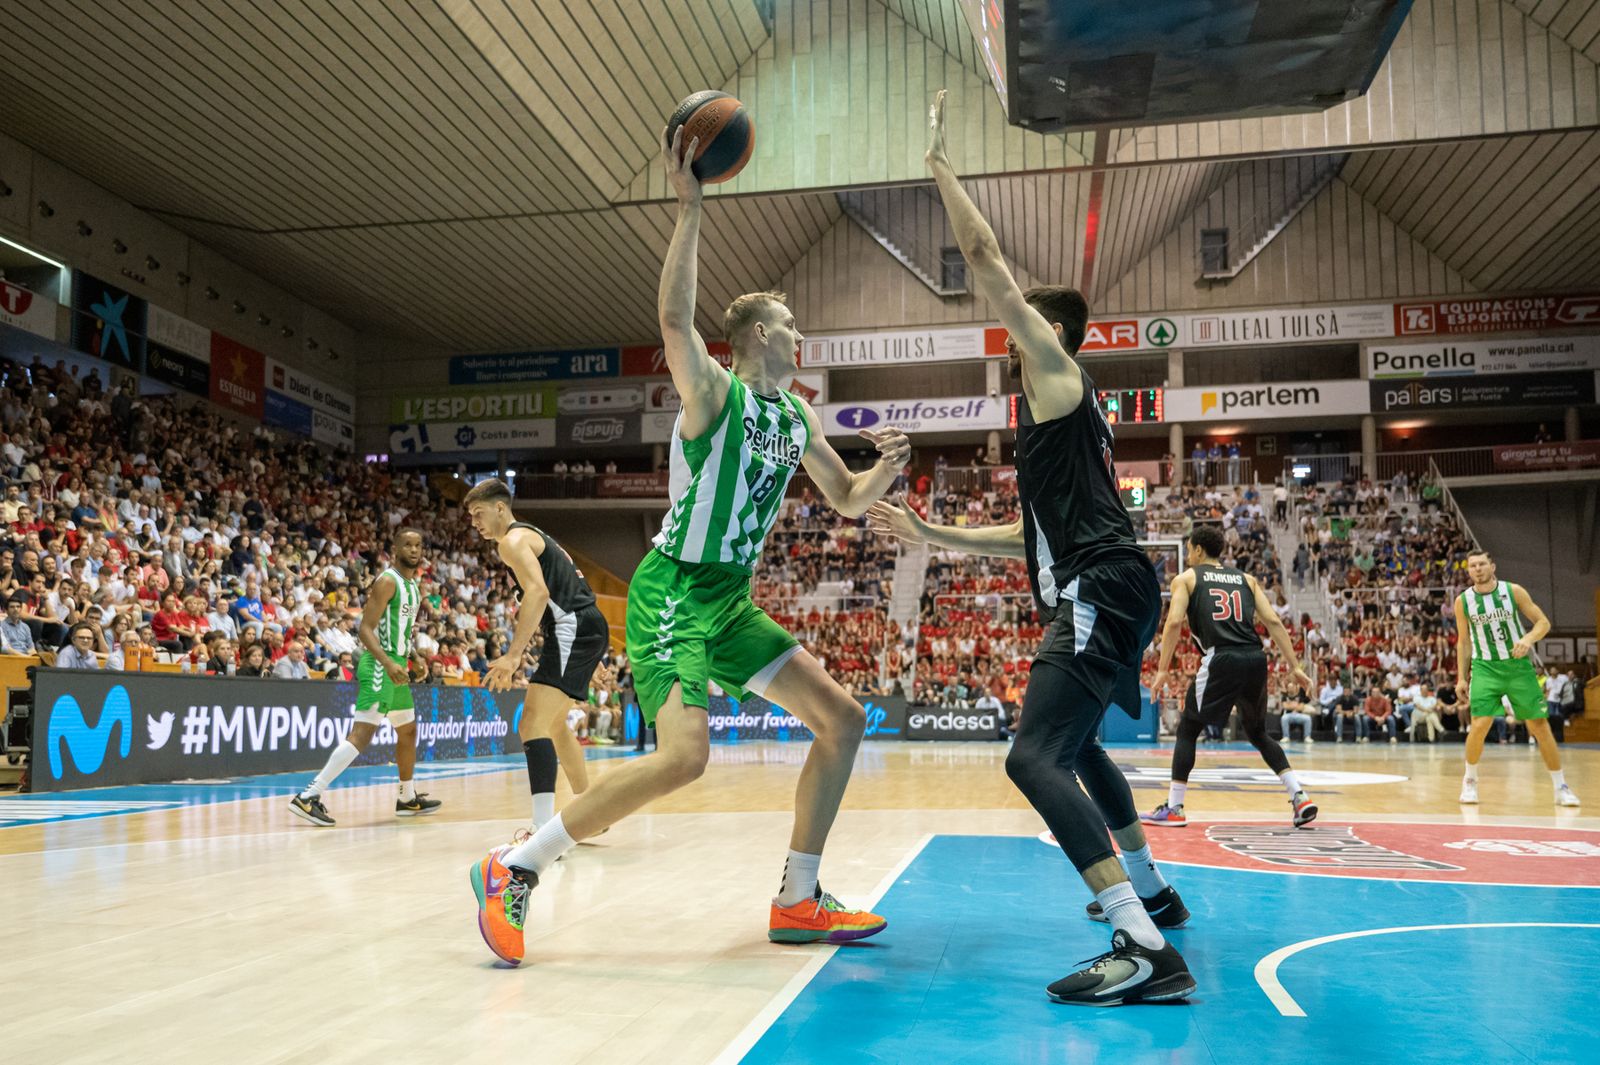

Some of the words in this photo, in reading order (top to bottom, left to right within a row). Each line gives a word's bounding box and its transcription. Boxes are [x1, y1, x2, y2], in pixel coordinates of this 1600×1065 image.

[1439, 297, 1556, 315] EQUIPACIONS
[1222, 317, 1273, 342] LLEAL
[1280, 310, 1339, 337] TULSÀ
[1447, 309, 1549, 325] ESPORTIVES
[1082, 325, 1136, 345] AR
[831, 340, 877, 362] LLEAL
[883, 333, 935, 360] TULSÀ
[1488, 342, 1575, 357] www.panella.cat
[162, 358, 185, 377] neorg
[571, 354, 608, 374] ara
[1373, 347, 1475, 371] Panella
[219, 378, 257, 404] ESTRELLA
[290, 376, 310, 398] Diari
[313, 387, 323, 403] de
[1222, 386, 1319, 413] parlem
[404, 393, 543, 421] L'ESPORTIU
[885, 400, 985, 420] infoself
[481, 432, 507, 441] Costa
[511, 429, 539, 439] Brava
[743, 416, 800, 461] Sevilla
[1500, 448, 1537, 462] girona
[1559, 446, 1571, 455] tu
[748, 469, 776, 504] 18
[1131, 487, 1144, 505] 9
[1203, 572, 1243, 585] JENKINS
[1209, 588, 1243, 622] 31
[1471, 609, 1511, 623] Sevilla
[1489, 628, 1507, 643] 13
[180, 703, 399, 755] #MVPMovia
[465, 714, 508, 742] favorito
[708, 712, 761, 731] ugador
[908, 711, 995, 731] endesa
